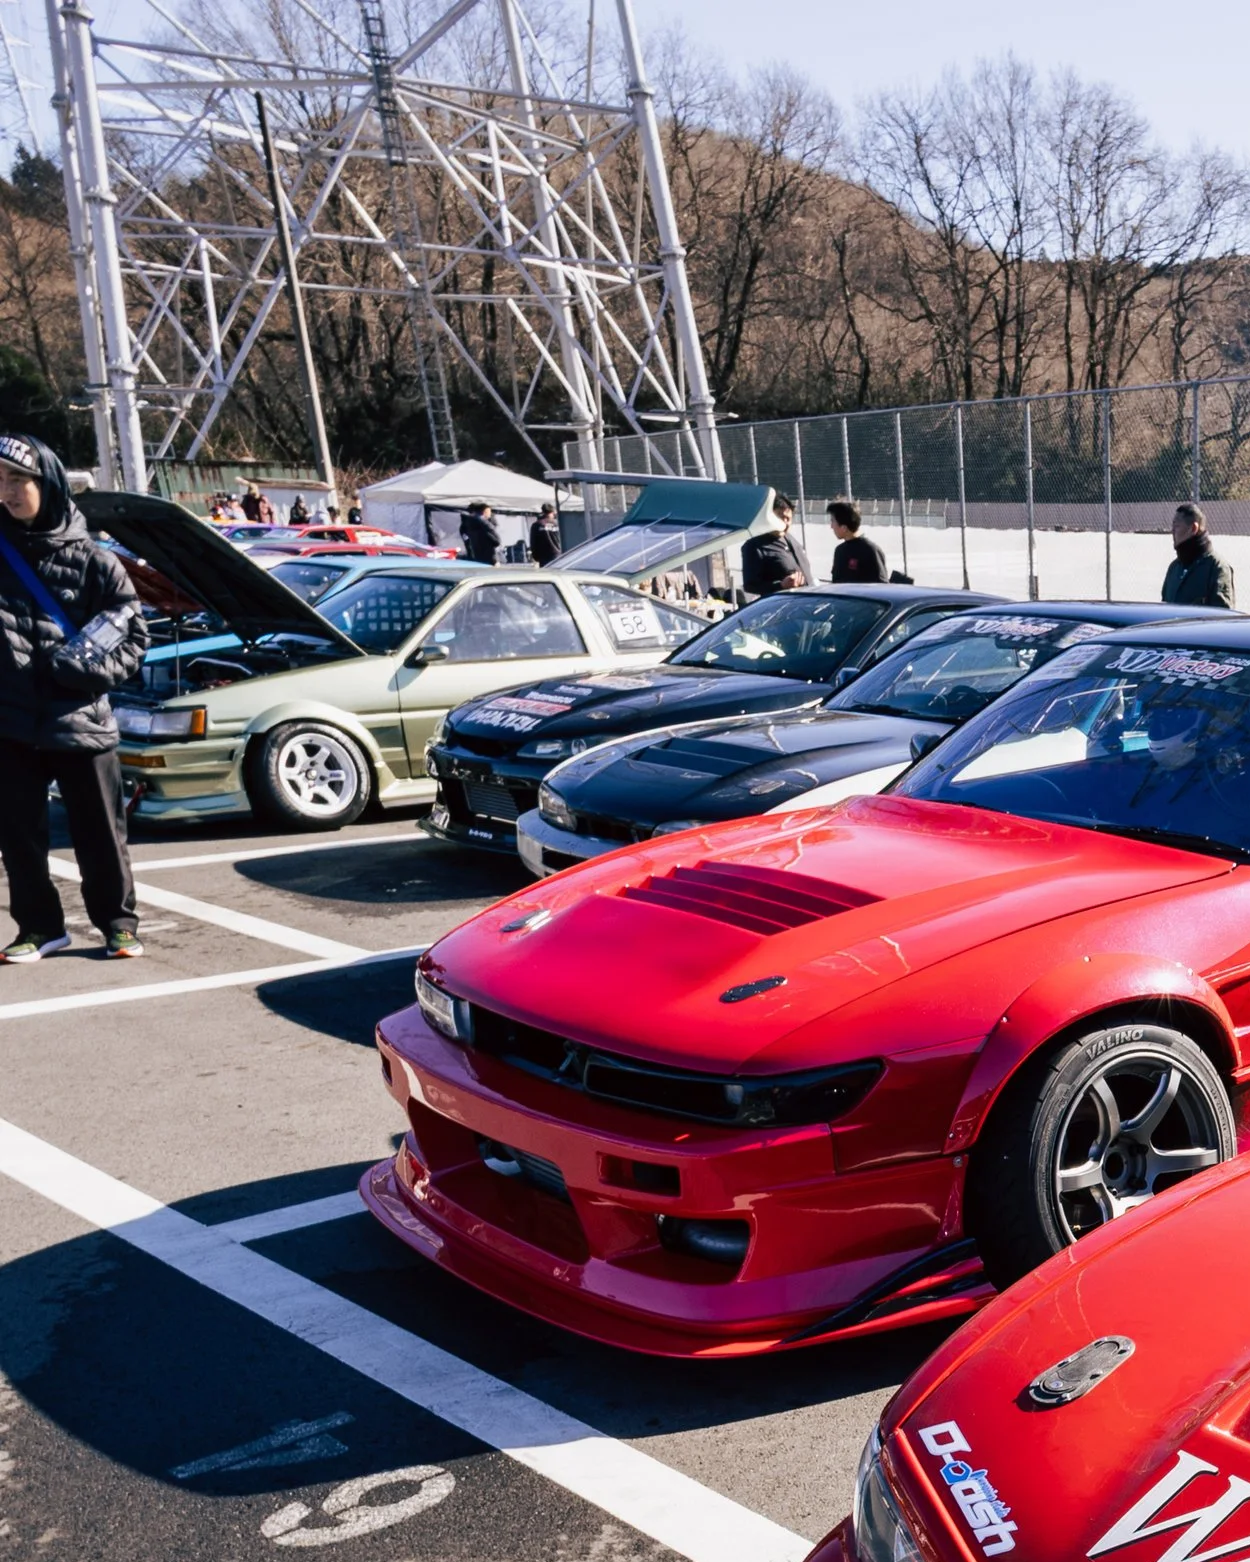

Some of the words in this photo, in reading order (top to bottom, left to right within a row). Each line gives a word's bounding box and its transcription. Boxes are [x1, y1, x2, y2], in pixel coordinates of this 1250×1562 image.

[620, 615, 647, 635] 58
[1156, 654, 1244, 680] Victory
[1085, 1027, 1145, 1061] VALINO
